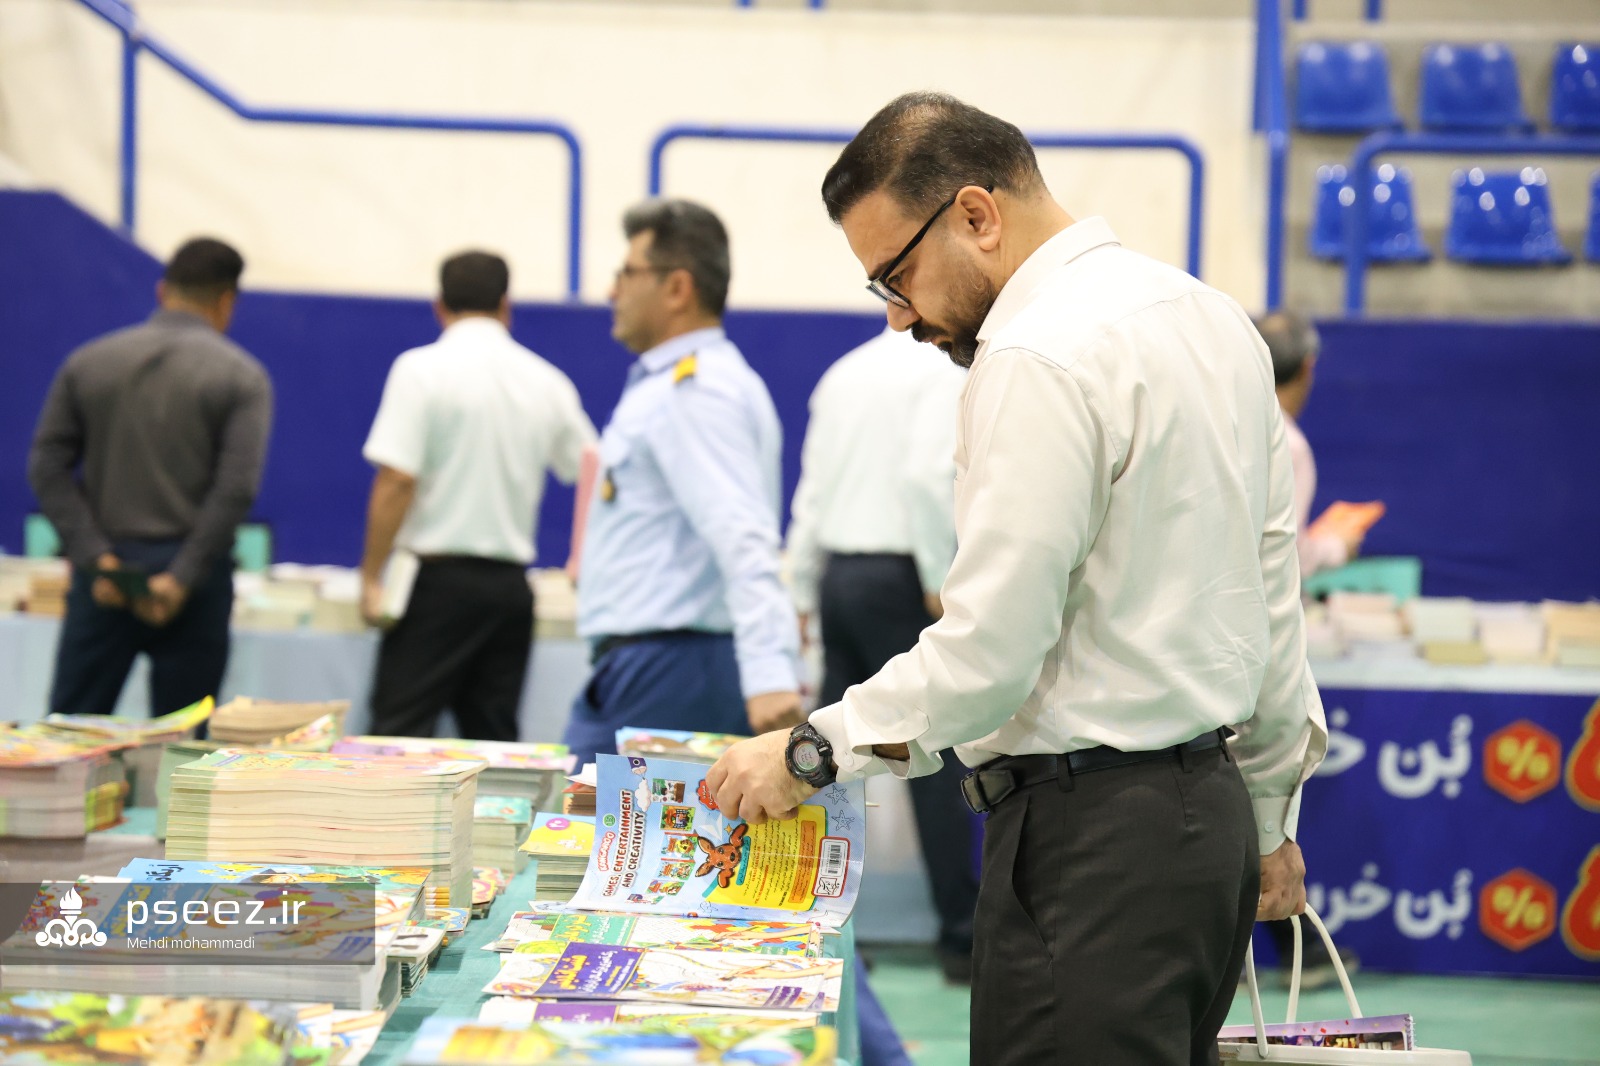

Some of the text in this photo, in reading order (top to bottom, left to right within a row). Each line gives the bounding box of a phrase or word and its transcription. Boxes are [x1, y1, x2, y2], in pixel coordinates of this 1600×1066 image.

[603, 790, 631, 897] GAMES, ENTERTAINMENT
[622, 812, 644, 888] AND CREATIVITY
